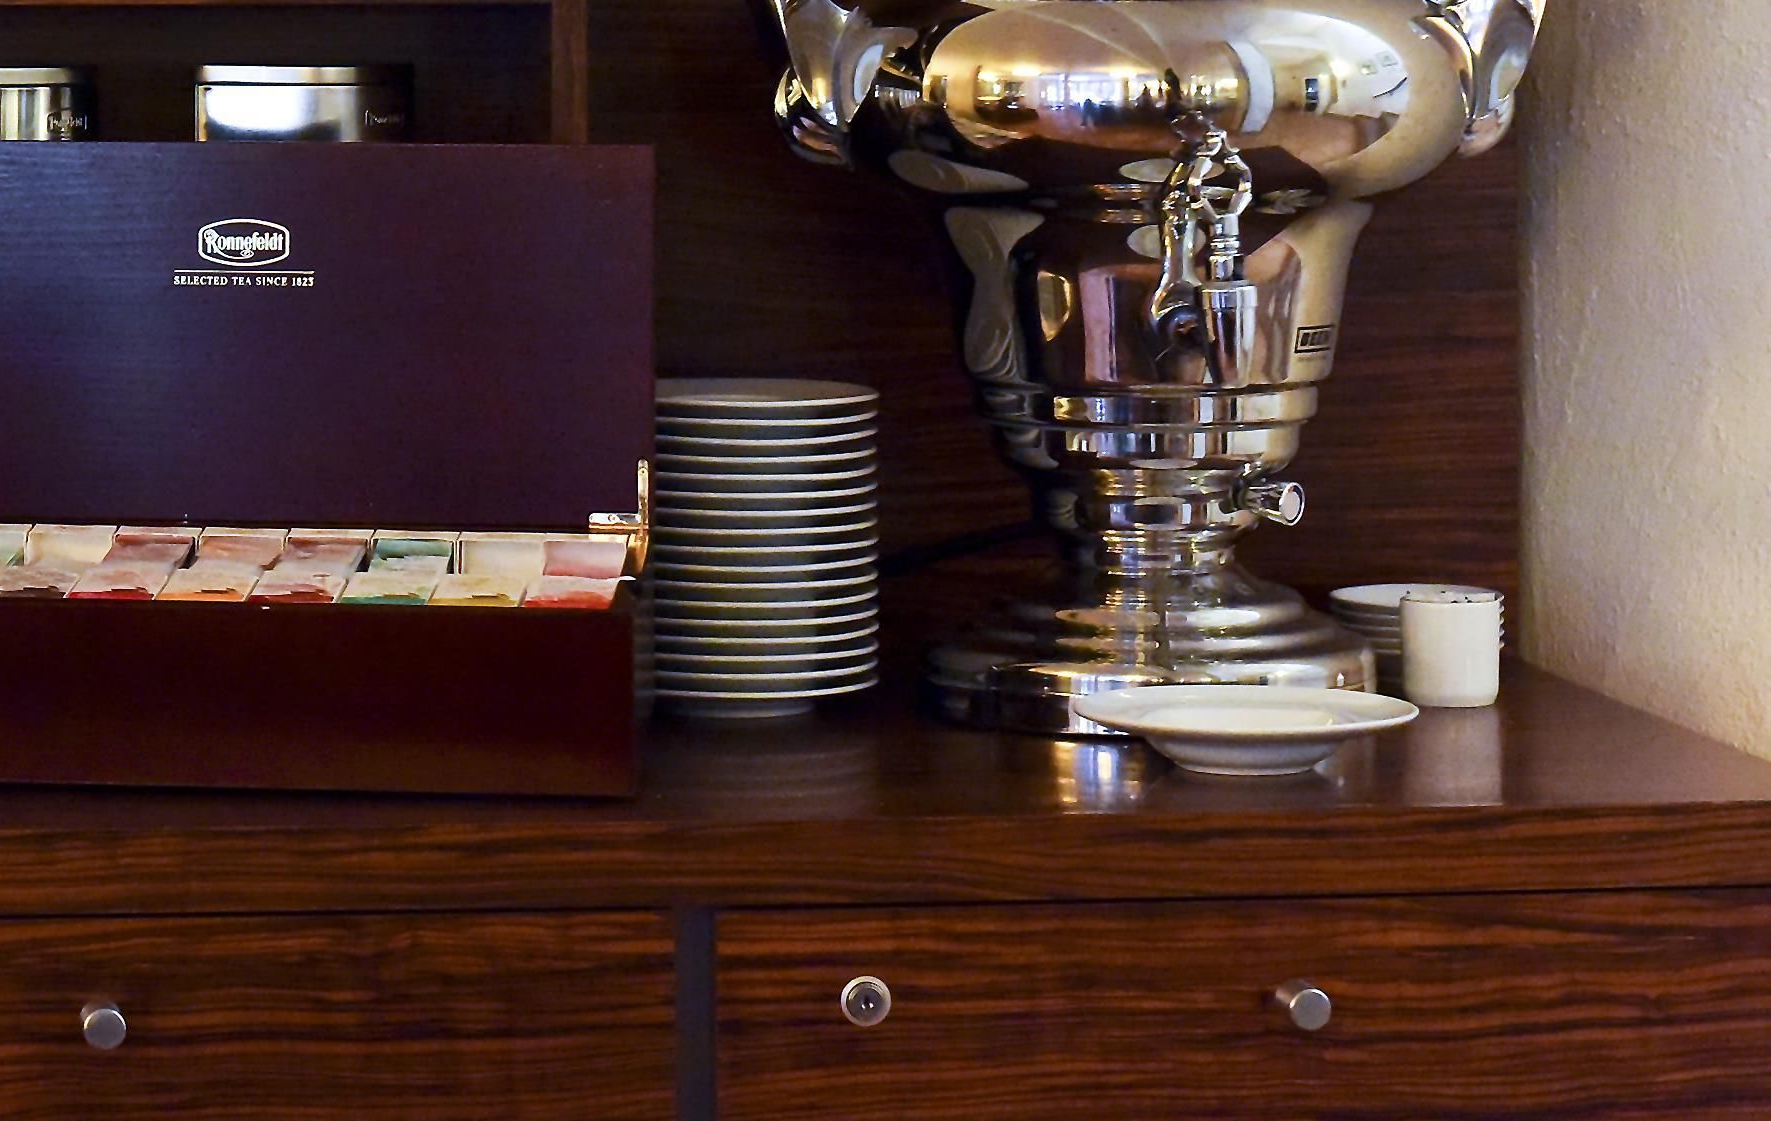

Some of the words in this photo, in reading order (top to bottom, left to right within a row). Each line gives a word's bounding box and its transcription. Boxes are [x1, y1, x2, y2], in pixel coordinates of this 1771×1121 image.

[203, 229, 284, 258] Ronnefeldt
[173, 275, 228, 286] SELECTED
[231, 276, 252, 286] TEA
[255, 276, 288, 286] SINCE
